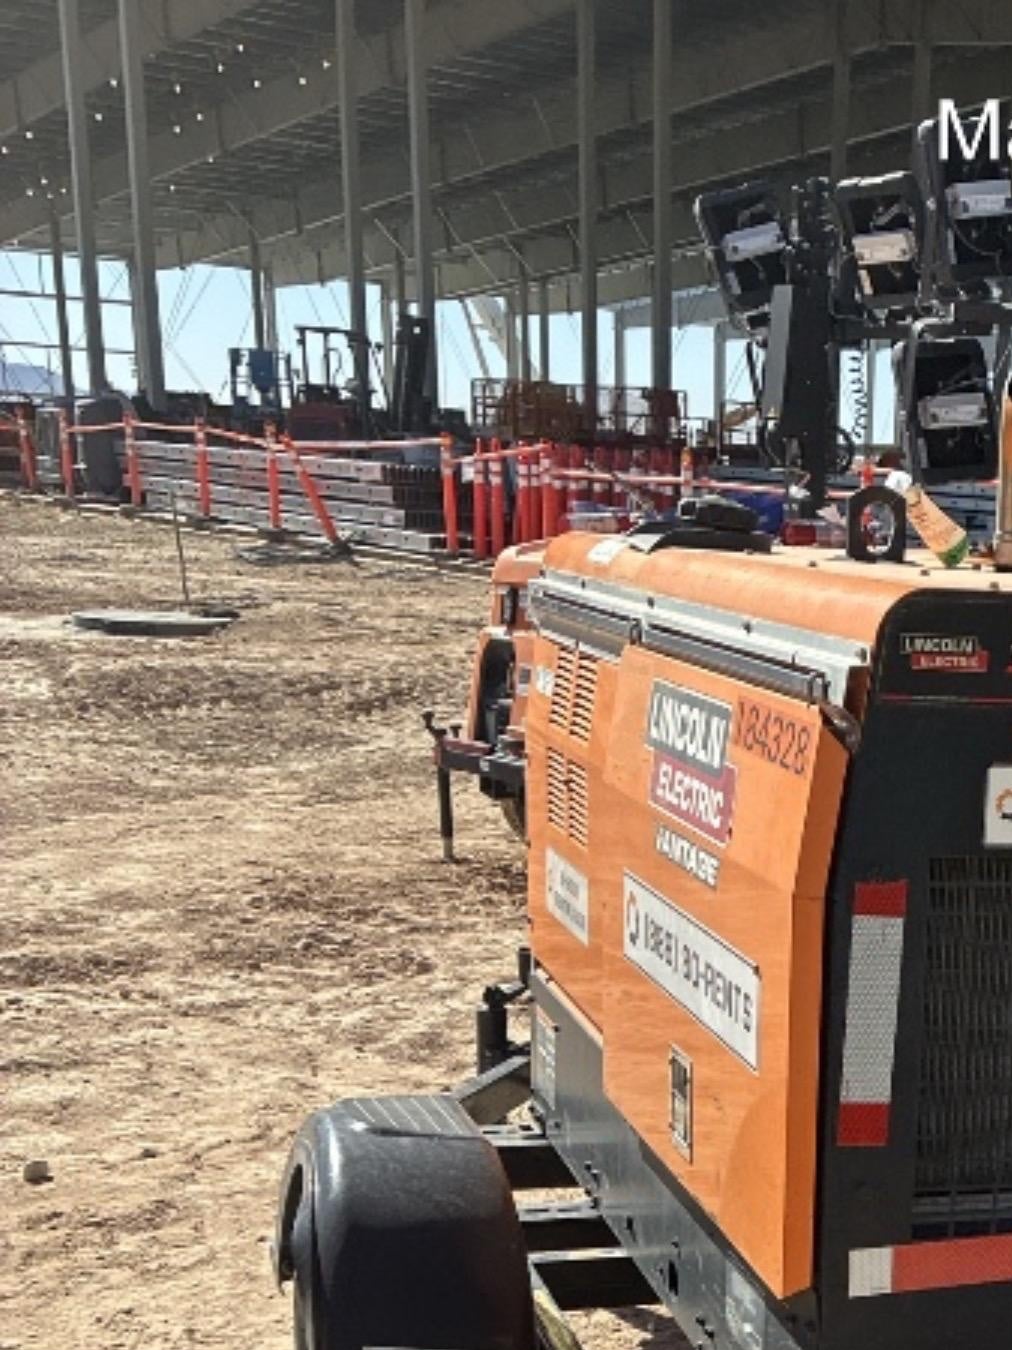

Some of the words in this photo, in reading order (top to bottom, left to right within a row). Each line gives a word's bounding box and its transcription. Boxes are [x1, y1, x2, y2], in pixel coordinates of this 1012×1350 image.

[904, 636, 975, 654] LINCOLN
[919, 655, 980, 668] ELECTRIC
[650, 693, 727, 769] LINCOLN
[736, 700, 810, 775] 184328
[656, 762, 724, 829] ELECTRIC
[656, 827, 721, 888] VANTAGE
